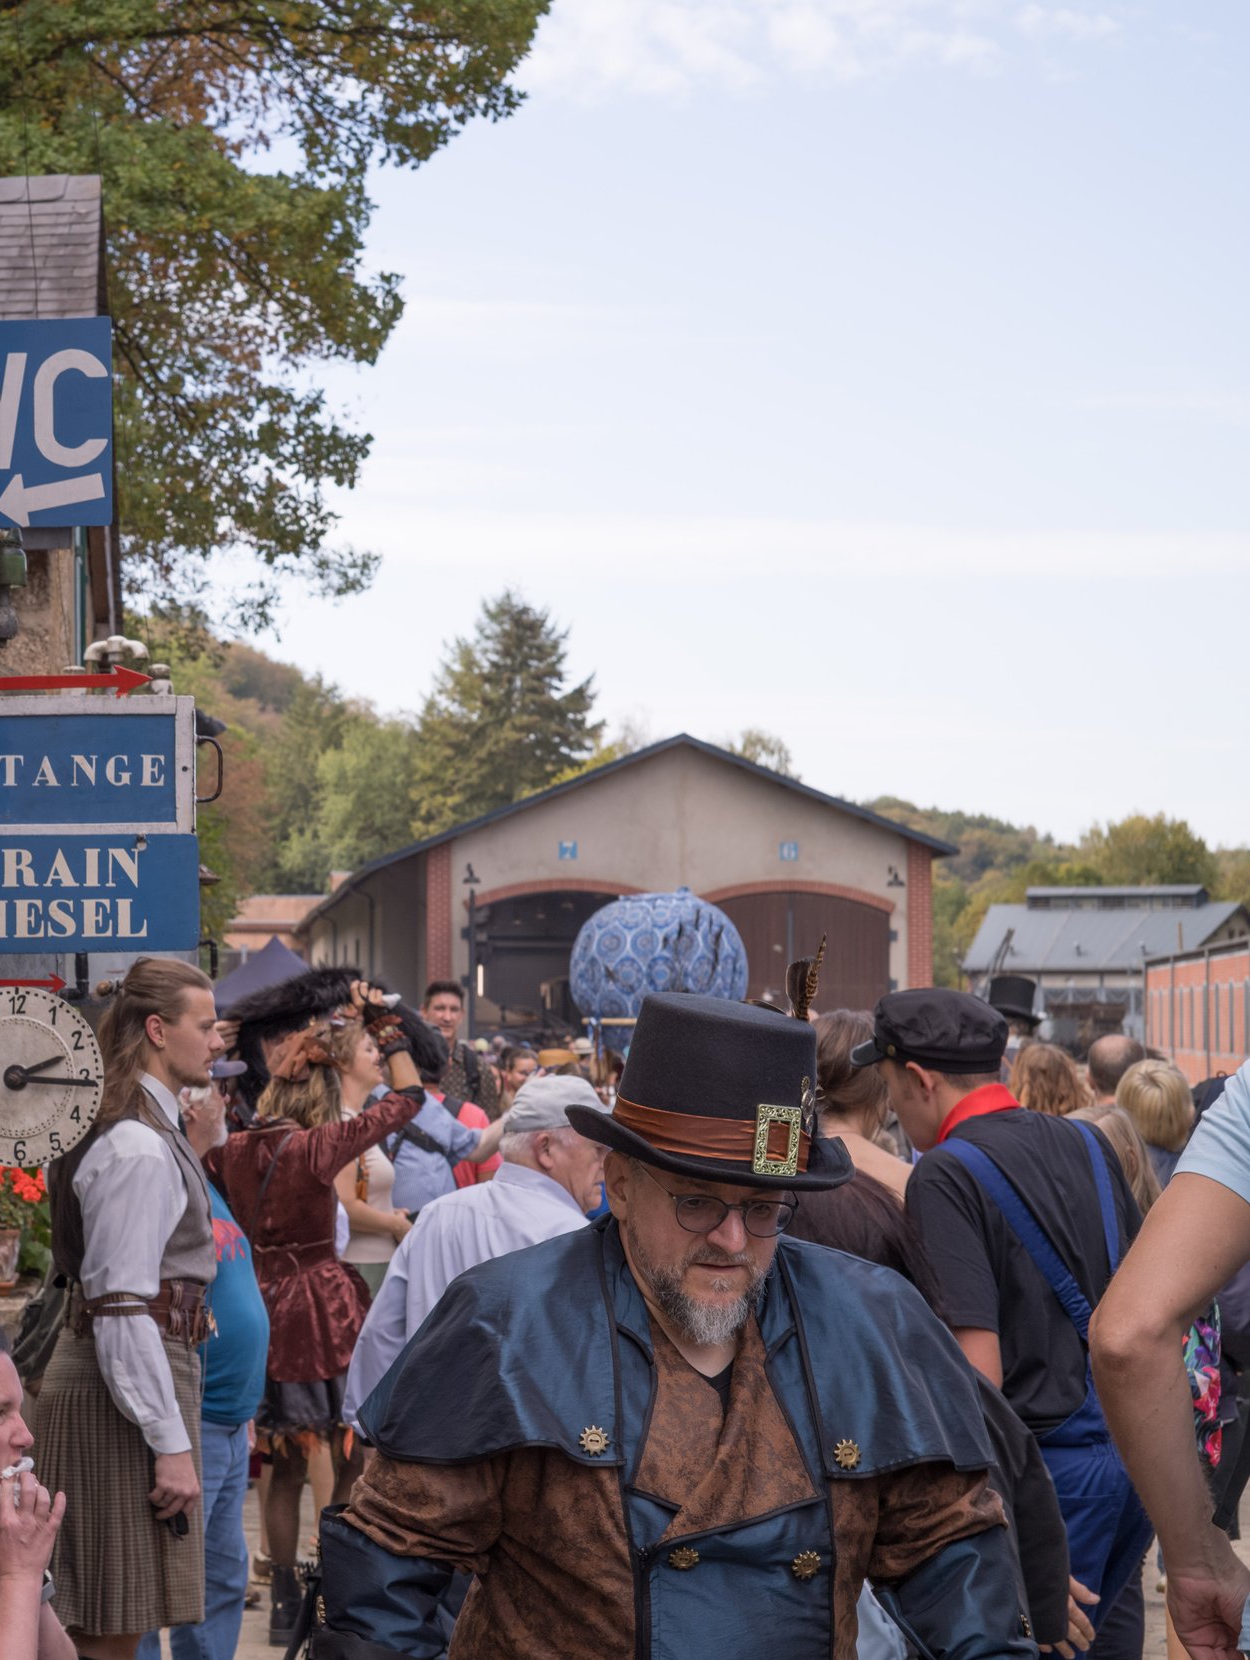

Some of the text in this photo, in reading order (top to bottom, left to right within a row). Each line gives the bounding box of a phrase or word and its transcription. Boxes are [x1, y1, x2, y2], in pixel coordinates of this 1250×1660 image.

[561, 841, 574, 860] 7
[782, 843, 796, 861] 6
[8, 995, 26, 1015] 12
[48, 1006, 57, 1026] 1
[71, 1030, 84, 1050] 2
[70, 1105, 81, 1124] 4
[14, 1140, 27, 1161] 6
[49, 1132, 61, 1151] 5
